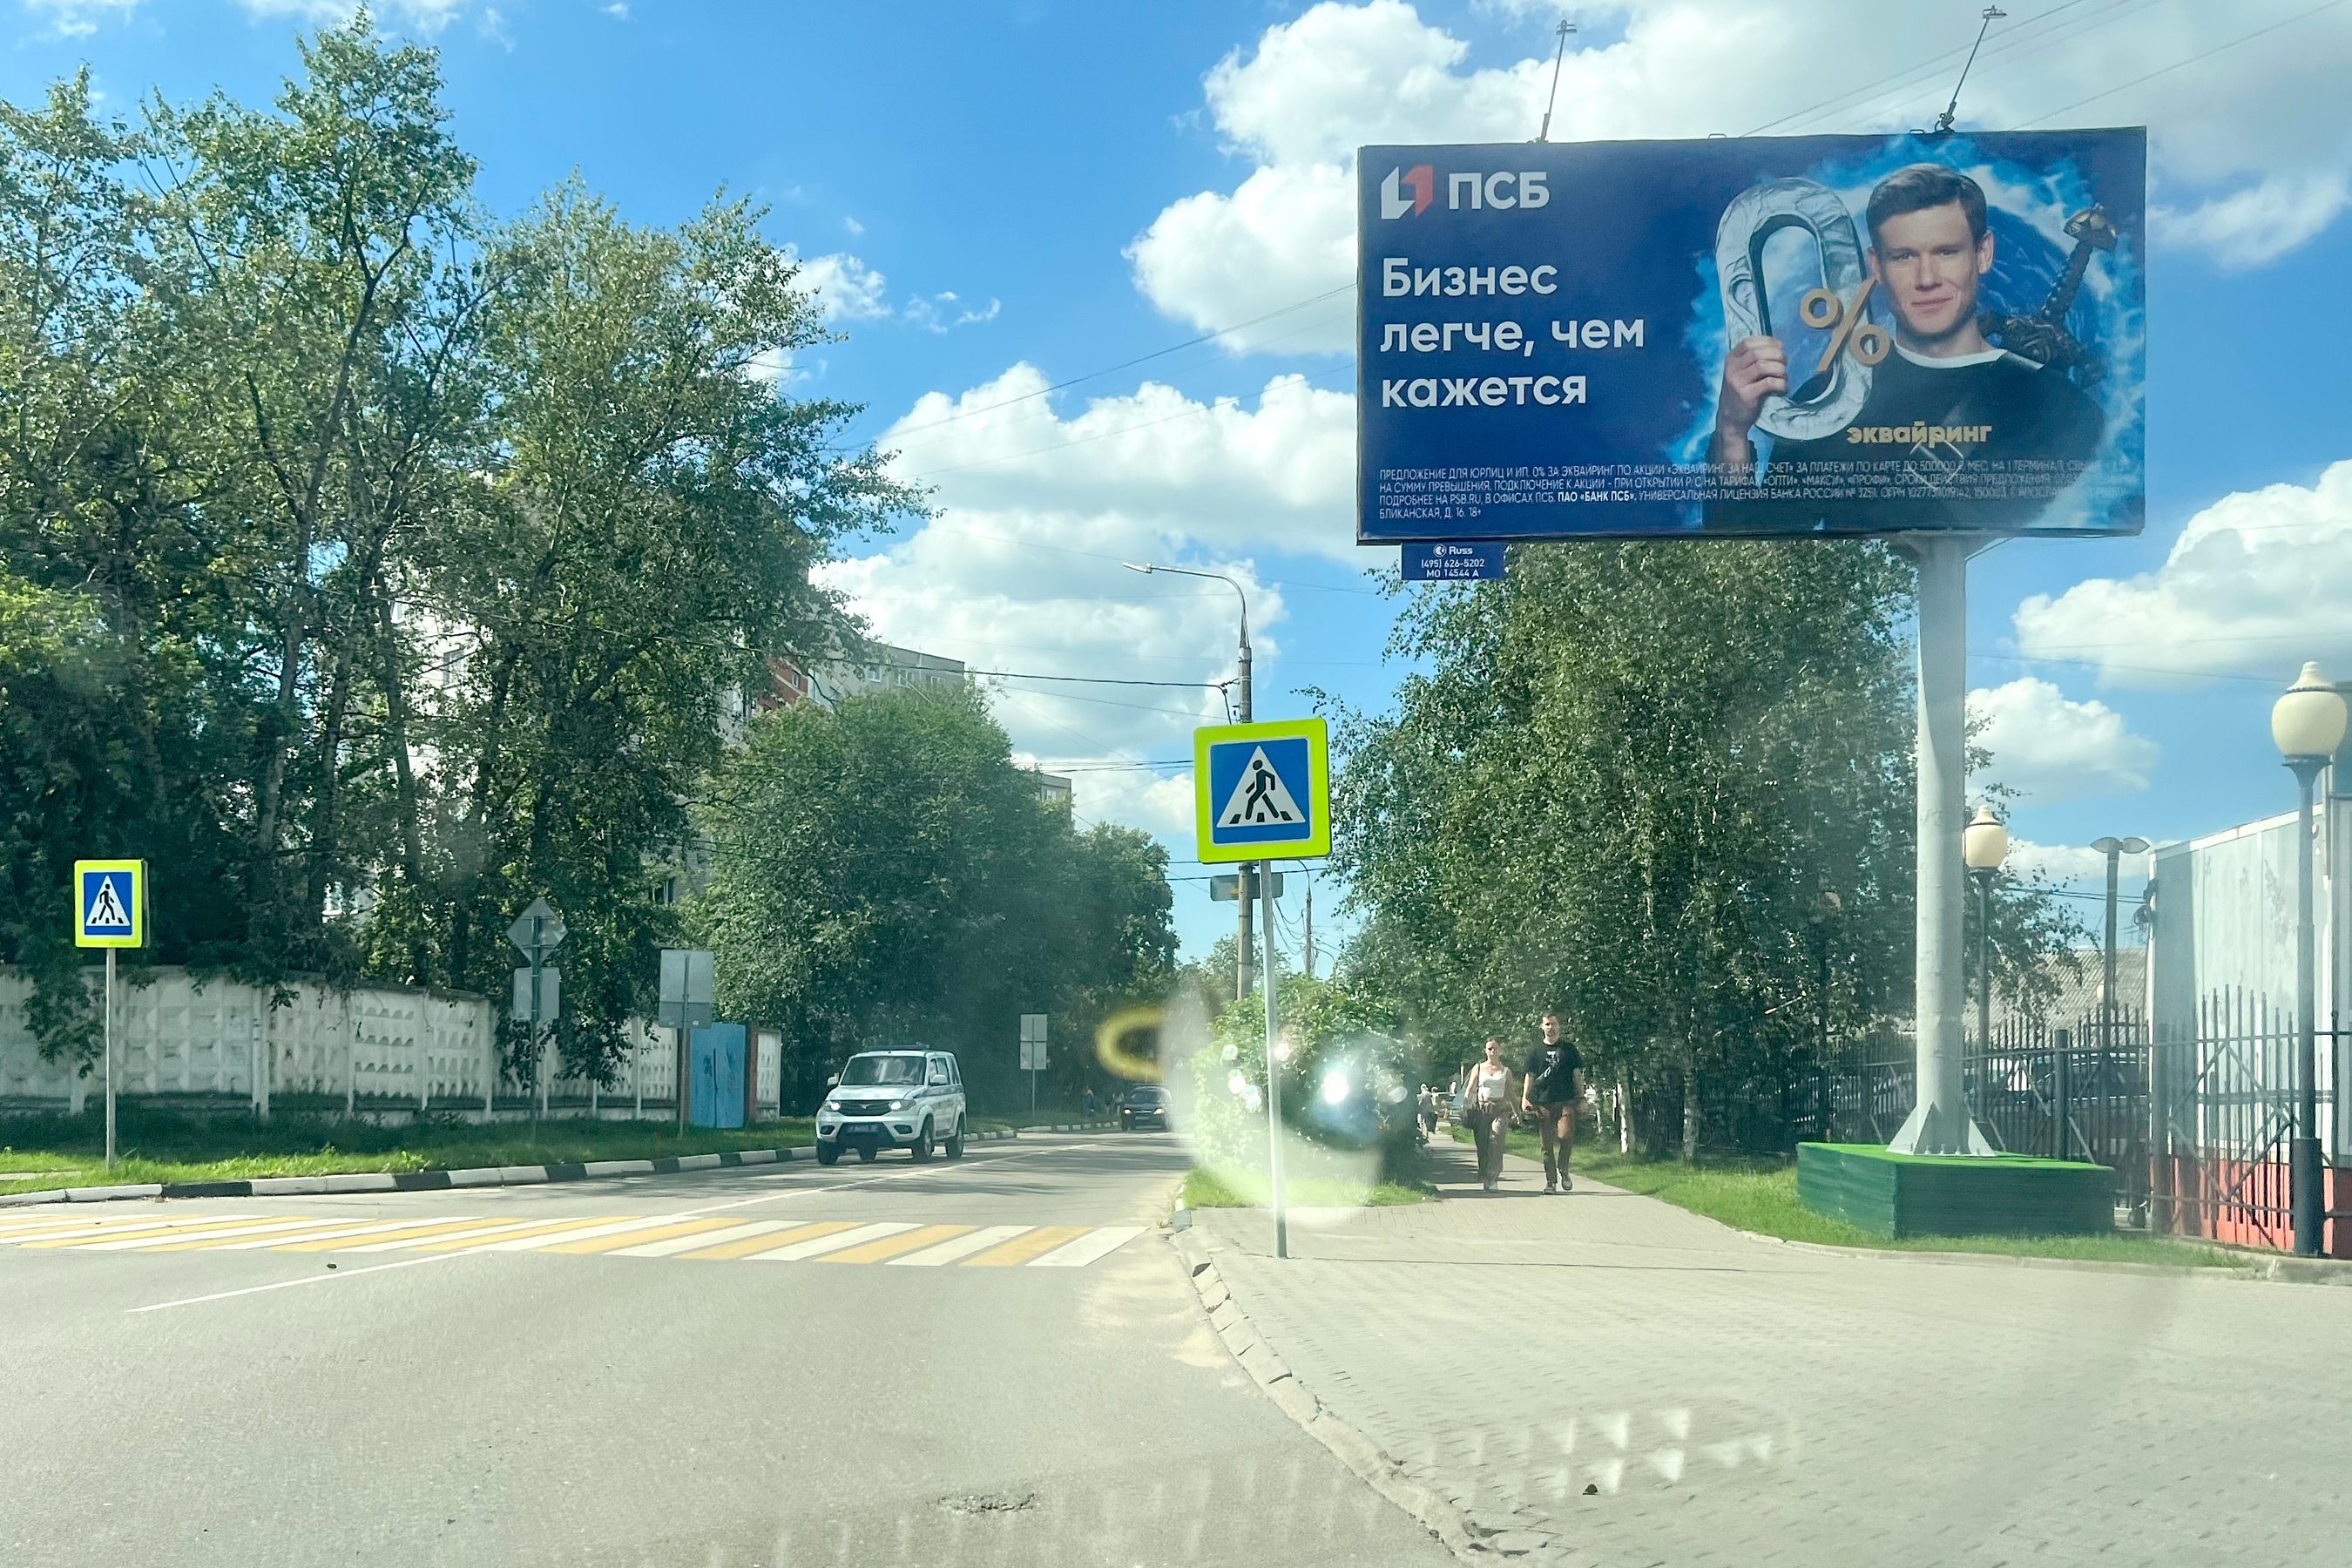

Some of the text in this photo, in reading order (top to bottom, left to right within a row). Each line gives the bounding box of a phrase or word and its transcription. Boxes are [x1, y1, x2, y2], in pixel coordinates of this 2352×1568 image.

[1448, 171, 1551, 211] ПСБ
[1382, 257, 1558, 297] Бизнес
[1380, 319, 1645, 357] легче, чем
[1382, 375, 1587, 408] кажется
[1846, 421, 1993, 449] эквайринг
[1379, 468, 1447, 482] ПРЕДЛОЖЕНИЕ
[1449, 467, 1468, 480] ДЛЯ
[1470, 466, 1504, 480] ЮРЛИЦ
[1506, 466, 1513, 478] И
[1532, 465, 1545, 477] 0%
[1547, 465, 1559, 477] ЗА
[1561, 463, 1615, 477] ЭКВАЙРИНГ
[1617, 464, 1632, 476] ПО
[1633, 464, 1665, 476] АКЦИИ
[1727, 463, 1740, 475] ЗА
[1796, 462, 1808, 474] ЗА
[1809, 461, 1855, 474] ПЛАТЕЖИ
[1855, 461, 1870, 473] ПО
[1873, 460, 1902, 472] КАРТЕ
[1379, 482, 1393, 494] НА
[1394, 482, 1427, 494] СУММУ
[1493, 478, 1565, 492] ПОДКЛЮЧЕНИЕ
[1565, 478, 1572, 490] К
[1574, 478, 1605, 490] АКЦИИ
[1613, 477, 1632, 490] ПРИ
[1634, 476, 1684, 489] ОТКРЫТИИ
[1704, 476, 1717, 488] НА
[1379, 494, 1435, 508] ПОДРОБНЕЕ
[1436, 494, 1449, 506] НА
[1484, 492, 1491, 504] В
[1492, 492, 1534, 505] ОФИСАХ
[1558, 490, 1578, 503] ПАО
[1579, 490, 1609, 503] «БАНК
[1639, 489, 1718, 503] УНИВЕРСАЛЬНАЯ
[1720, 488, 1769, 502] ЛИЦЕНЗИЯ
[1770, 487, 1802, 500] БАНКА
[1379, 507, 1442, 520] БЛИКАНСКАЯ,
[1469, 506, 1482, 518] 18+
[1448, 545, 1474, 556] Russ
[1421, 558, 1485, 569] (495) 626-5202
[1443, 569, 1470, 578] 14544
